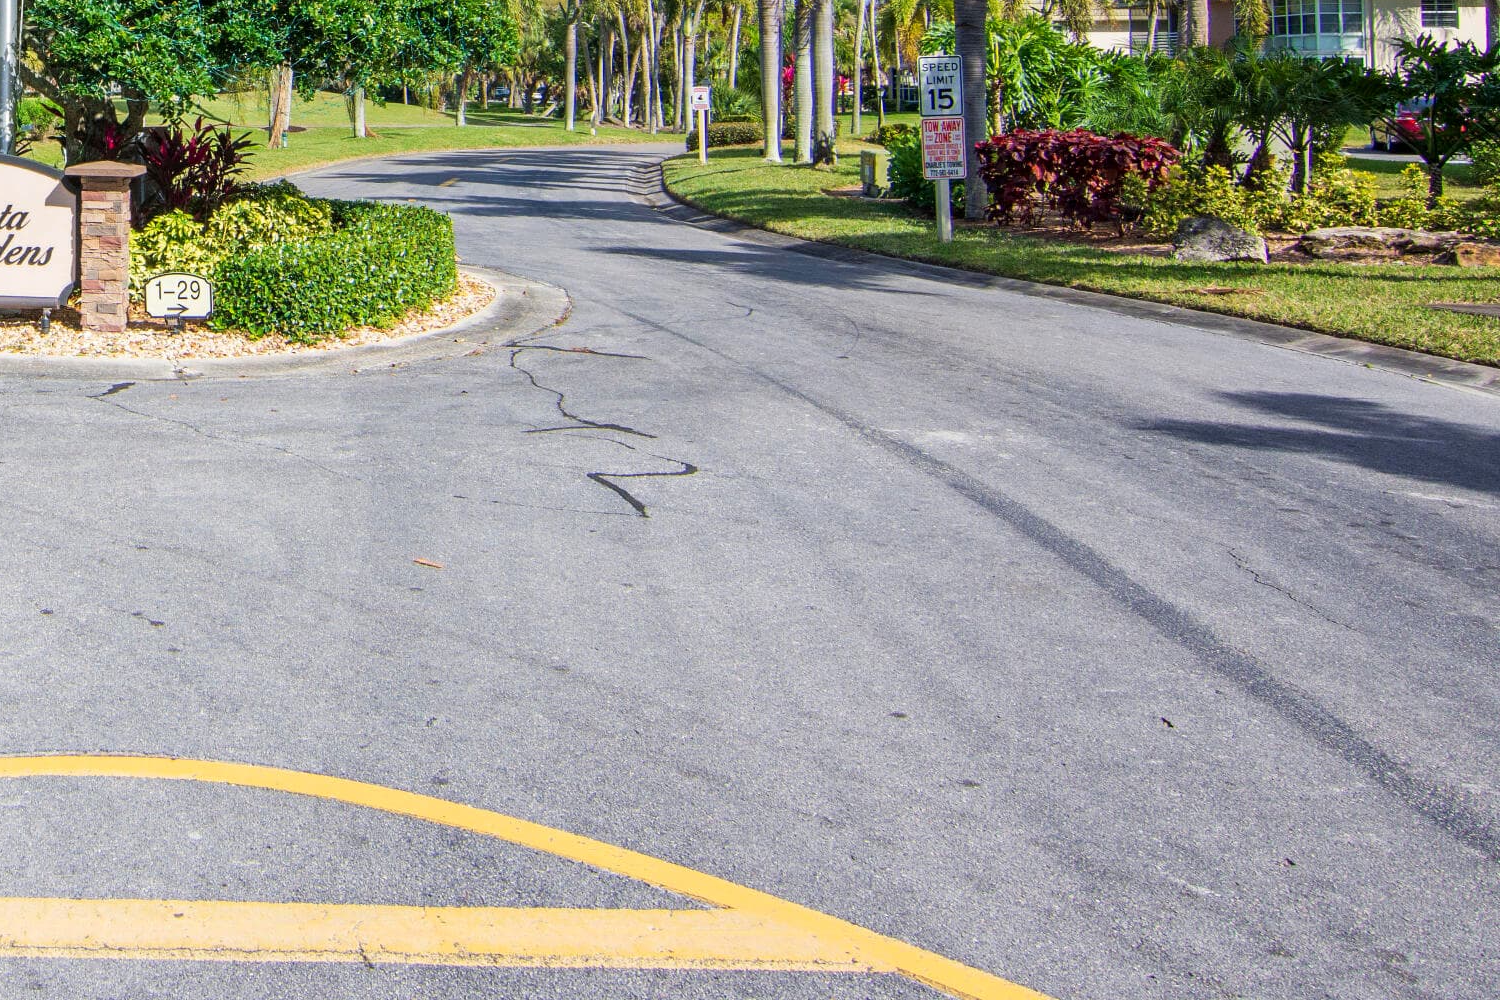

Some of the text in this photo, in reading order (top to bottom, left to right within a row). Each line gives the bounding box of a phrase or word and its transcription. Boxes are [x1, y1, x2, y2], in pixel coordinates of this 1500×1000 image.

[922, 63, 958, 71] SPEED
[926, 75, 954, 85] LIMIT
[928, 88, 954, 110] 15
[924, 120, 960, 132] TOW AWAY
[934, 132, 952, 143] ZONE
[155, 280, 200, 300] 1-29
